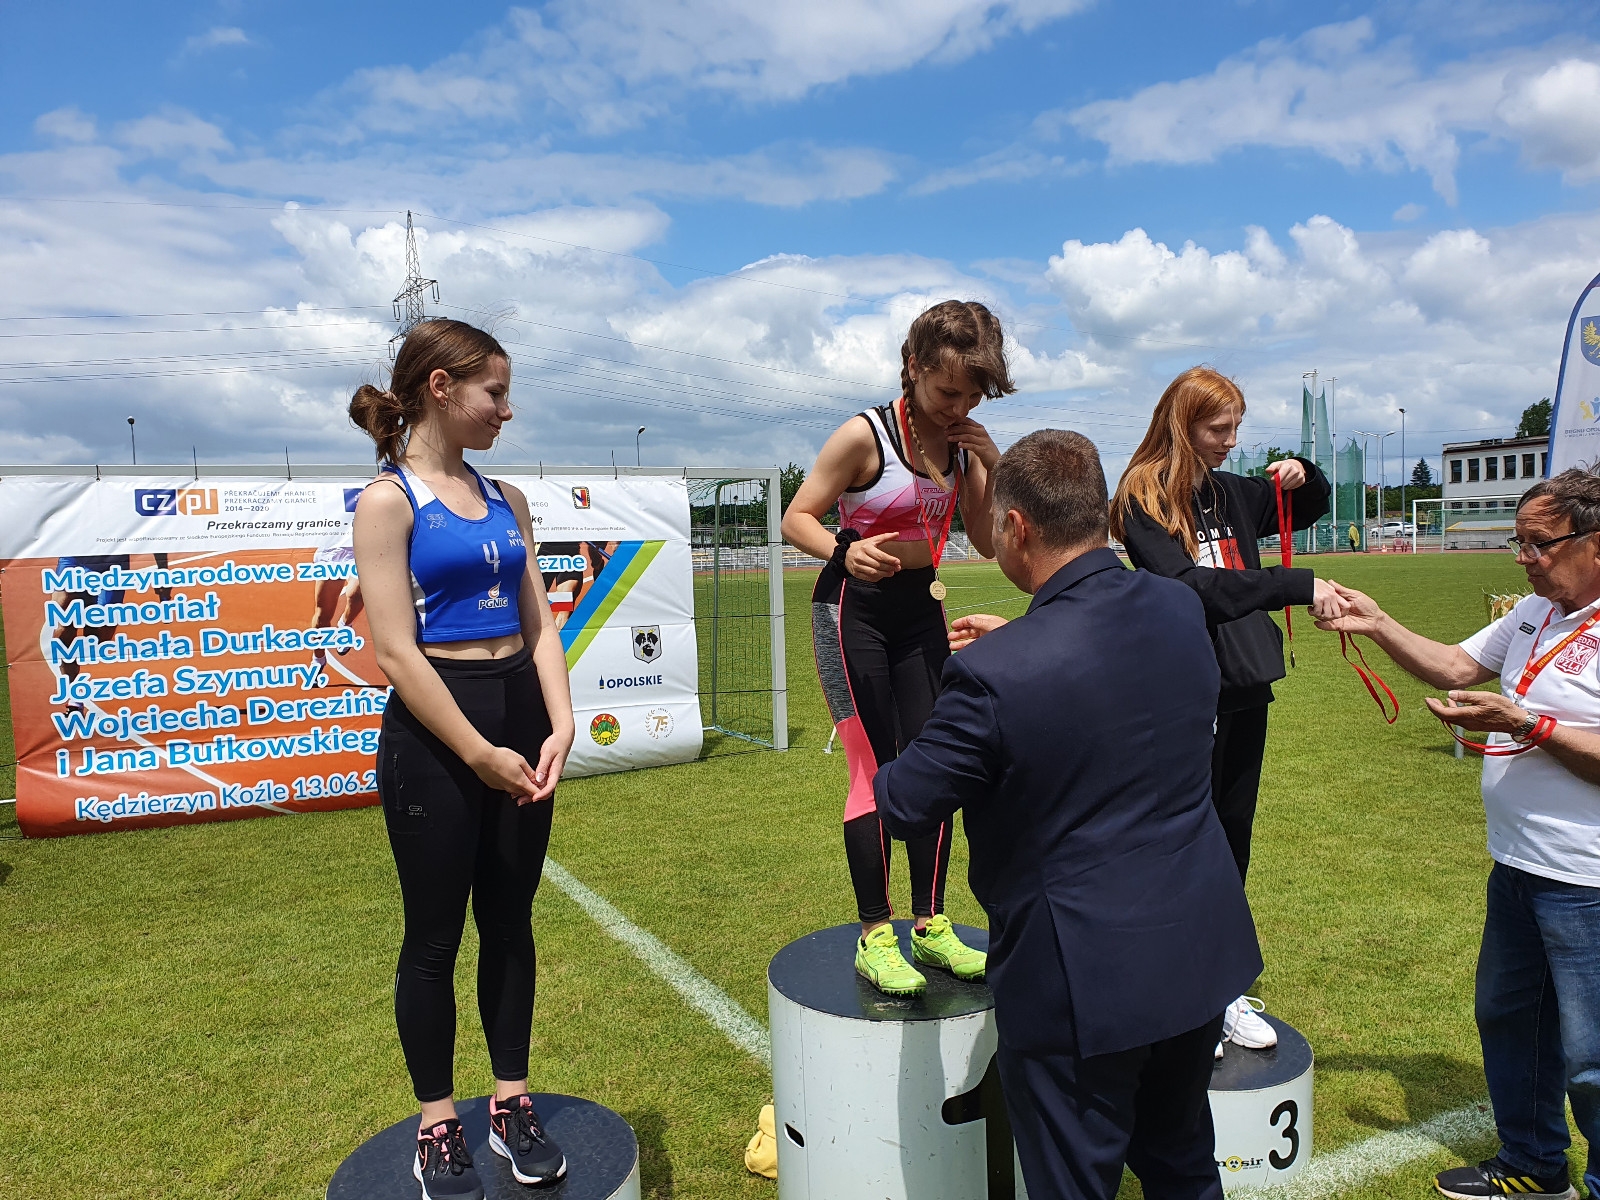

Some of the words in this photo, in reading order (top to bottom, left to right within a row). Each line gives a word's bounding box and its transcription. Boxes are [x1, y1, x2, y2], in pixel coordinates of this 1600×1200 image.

[207, 520, 293, 532] Przekraczamy
[296, 519, 341, 531] granice
[482, 540, 500, 574] 4
[44, 562, 291, 592] Międzynarodowe
[47, 594, 217, 626] Memoriał
[478, 597, 508, 610] PGNiG
[50, 633, 191, 664] Michała
[202, 626, 362, 654] Durkacza,
[1557, 657, 1581, 672] PZLA
[52, 671, 165, 702] Józefa
[175, 665, 327, 694] Szymury,
[606, 675, 663, 689] OPOLSKIE
[54, 703, 238, 739] Wojciecha
[249, 689, 393, 722] Derezińs
[58, 752, 67, 775] i
[78, 750, 156, 774] Jana
[78, 793, 214, 821] Kędzierzyn
[222, 782, 286, 806] Koźle
[1269, 1100, 1299, 1170] 3
